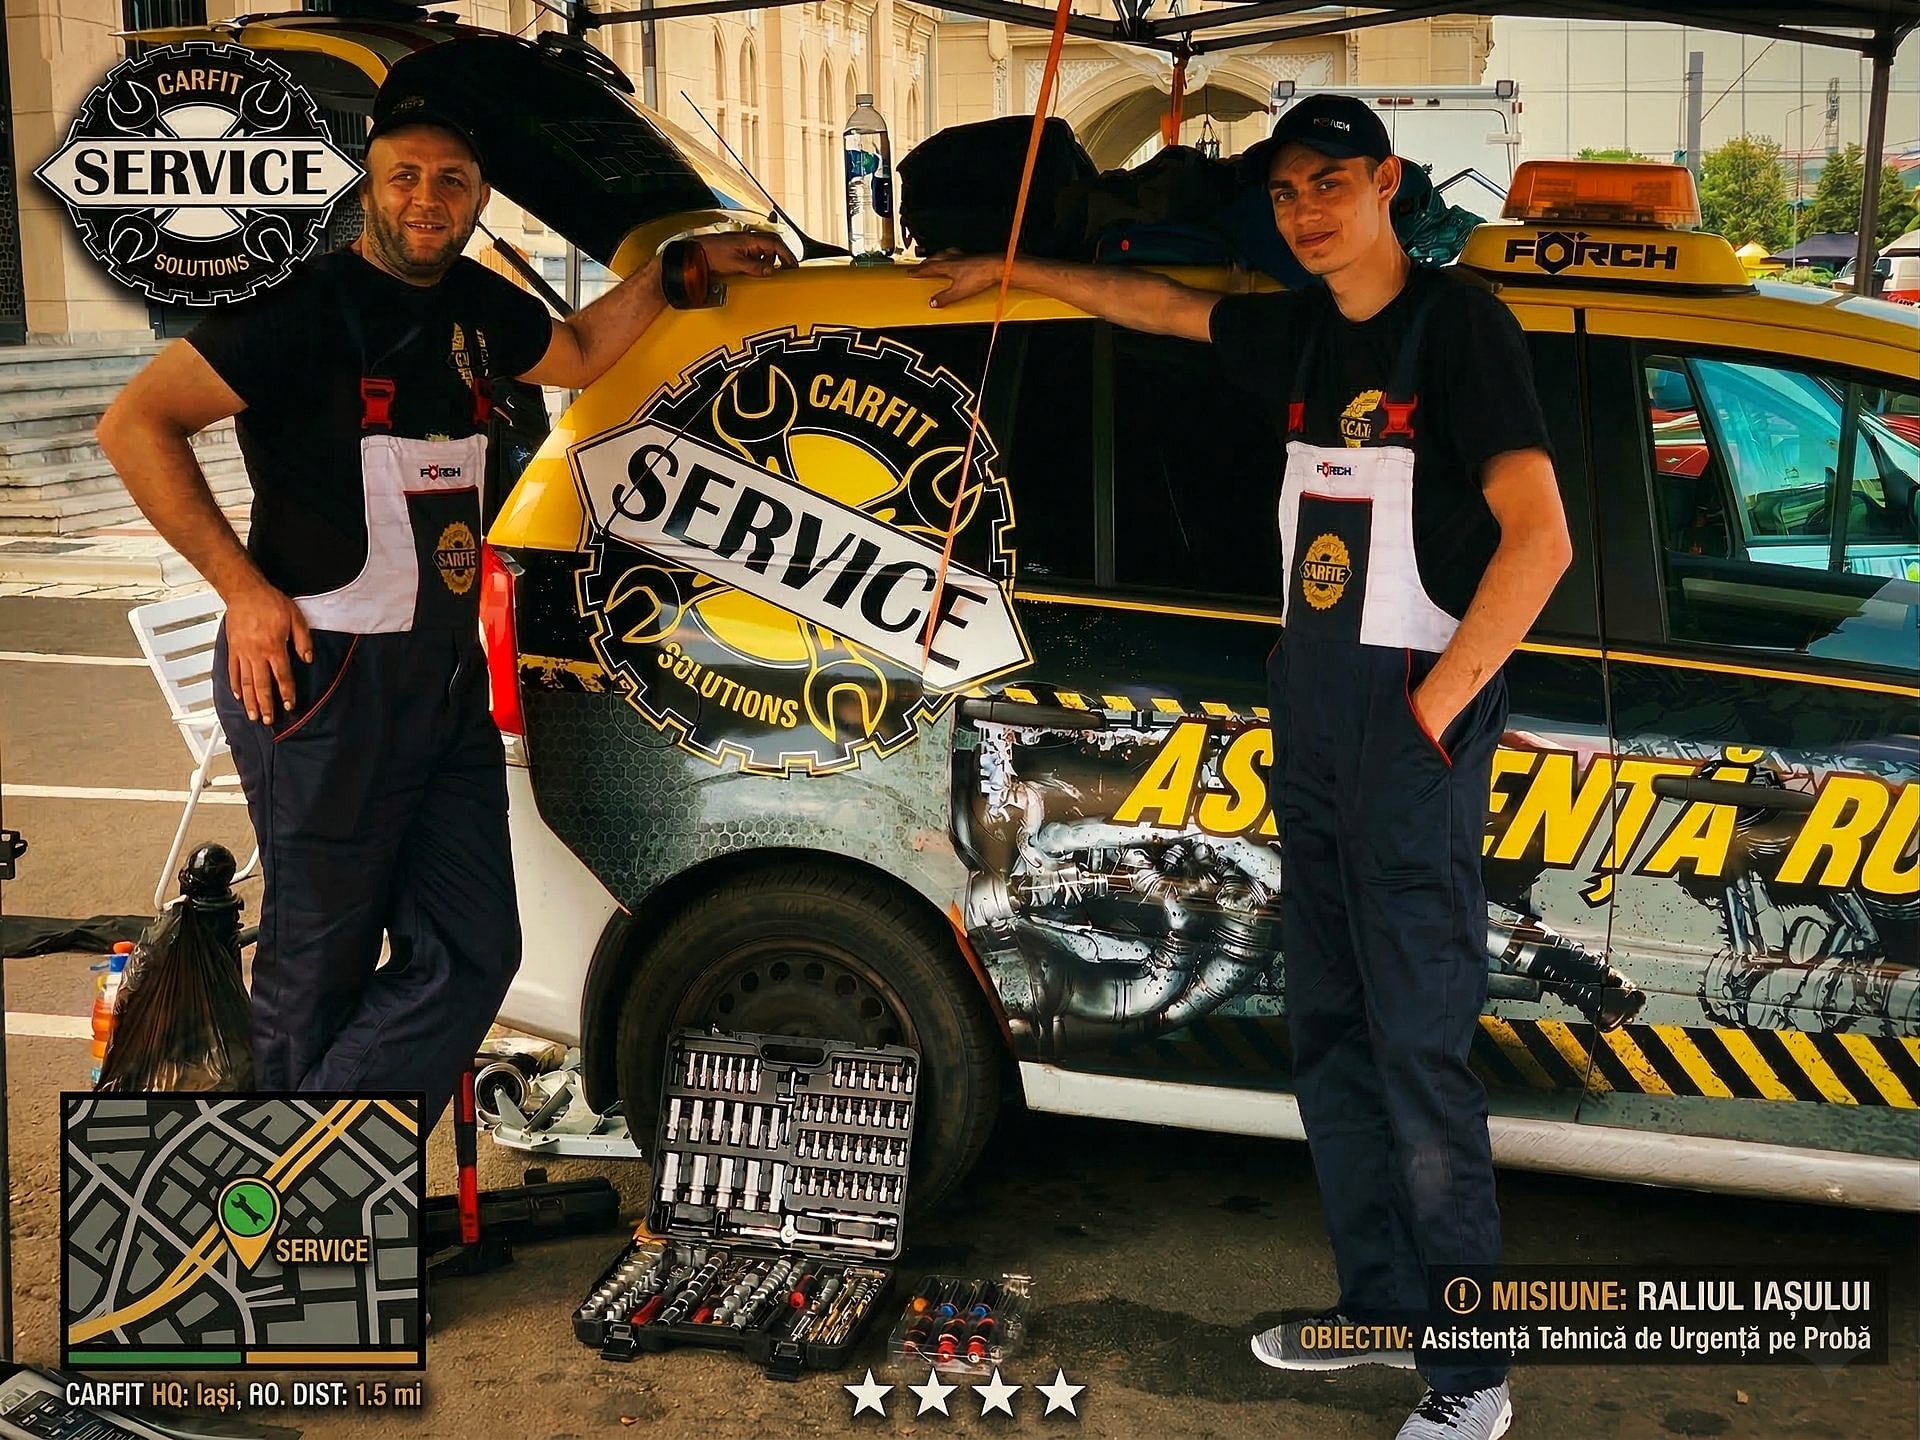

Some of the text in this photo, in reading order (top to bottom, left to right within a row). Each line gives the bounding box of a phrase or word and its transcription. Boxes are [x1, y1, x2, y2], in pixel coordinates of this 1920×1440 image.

[809, 373, 938, 447] CARFIT
[612, 444, 988, 671] SERVICE
[657, 642, 799, 729] SOLUTIONS
